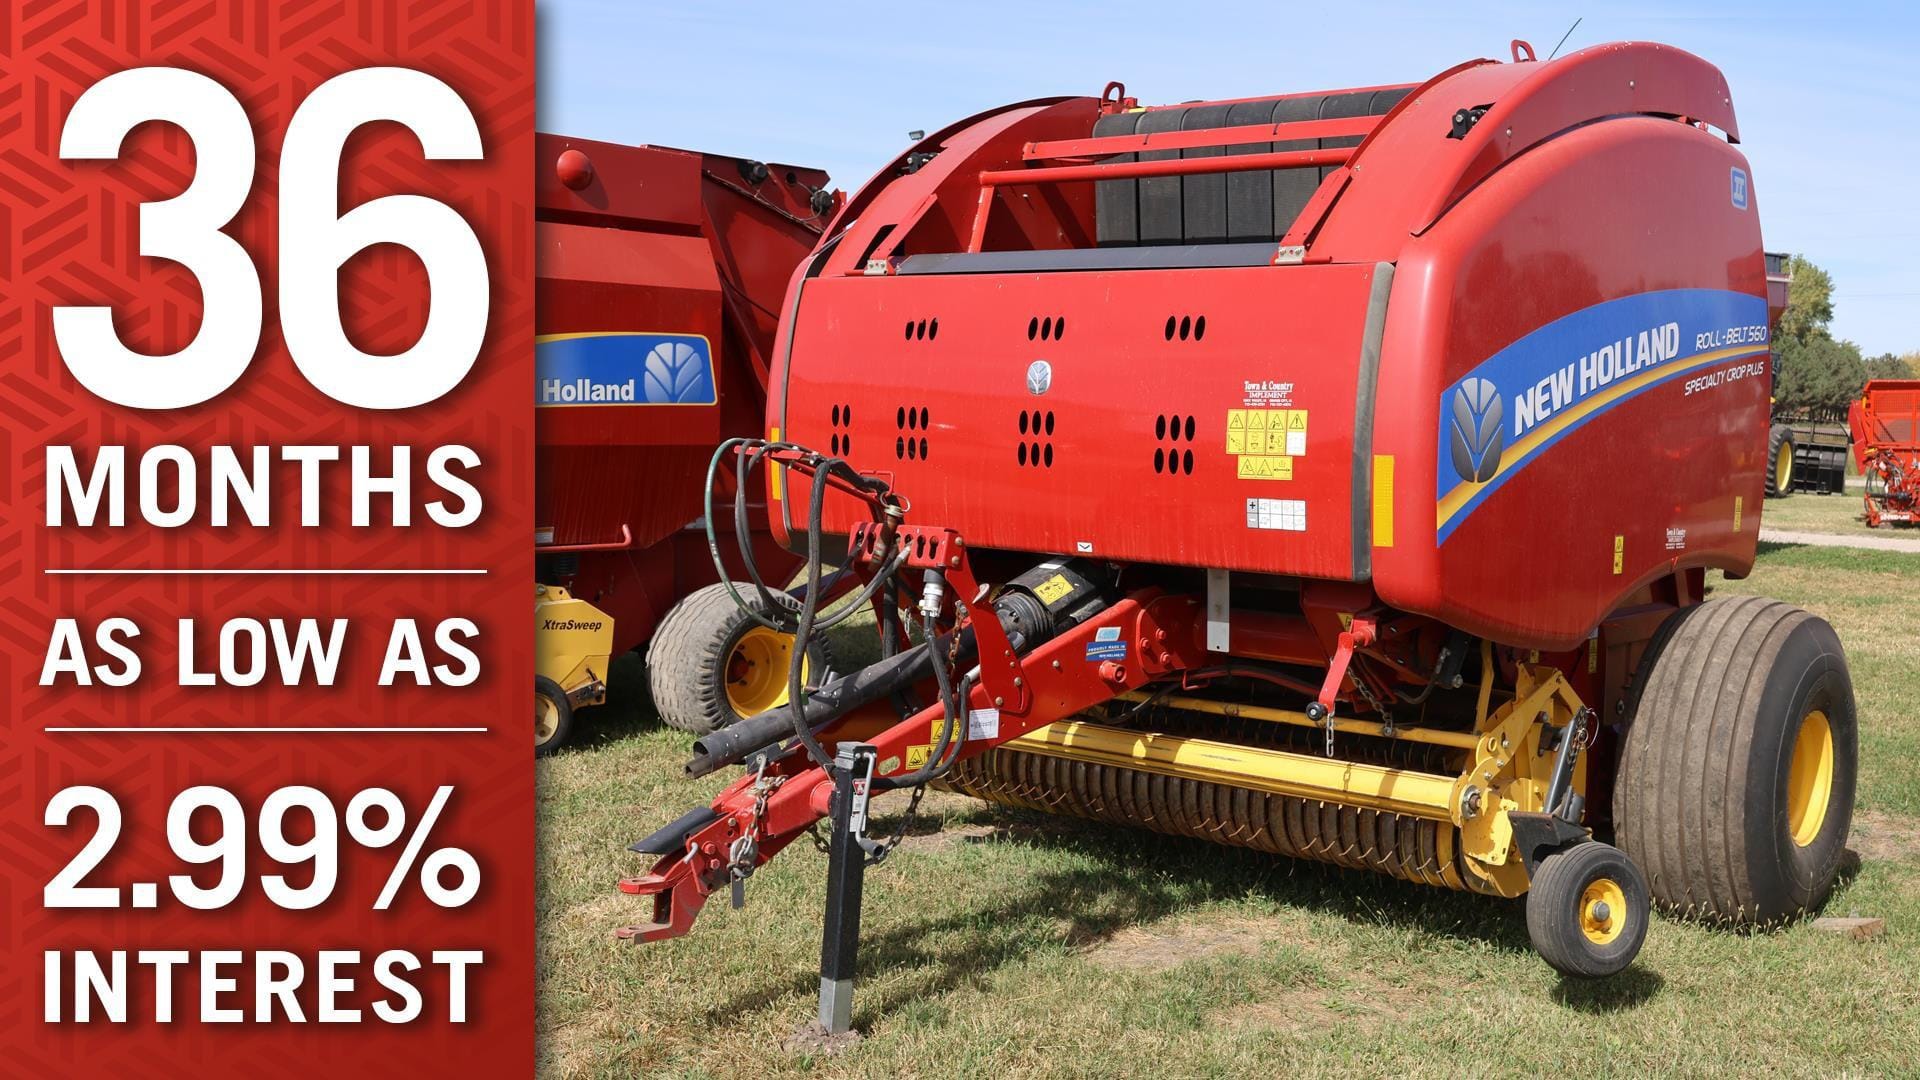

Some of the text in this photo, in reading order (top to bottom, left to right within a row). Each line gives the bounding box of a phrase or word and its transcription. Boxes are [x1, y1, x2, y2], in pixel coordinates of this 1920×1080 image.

[1748, 325, 1767, 342] 560
[1244, 380, 1294, 392] Town & Country
[1515, 322, 1680, 437] NEW HOLLAND
[1684, 361, 1764, 396] SPECIALTY CROP PLUS
[541, 378, 635, 402] Holland
[542, 619, 602, 632] XtraSweep
